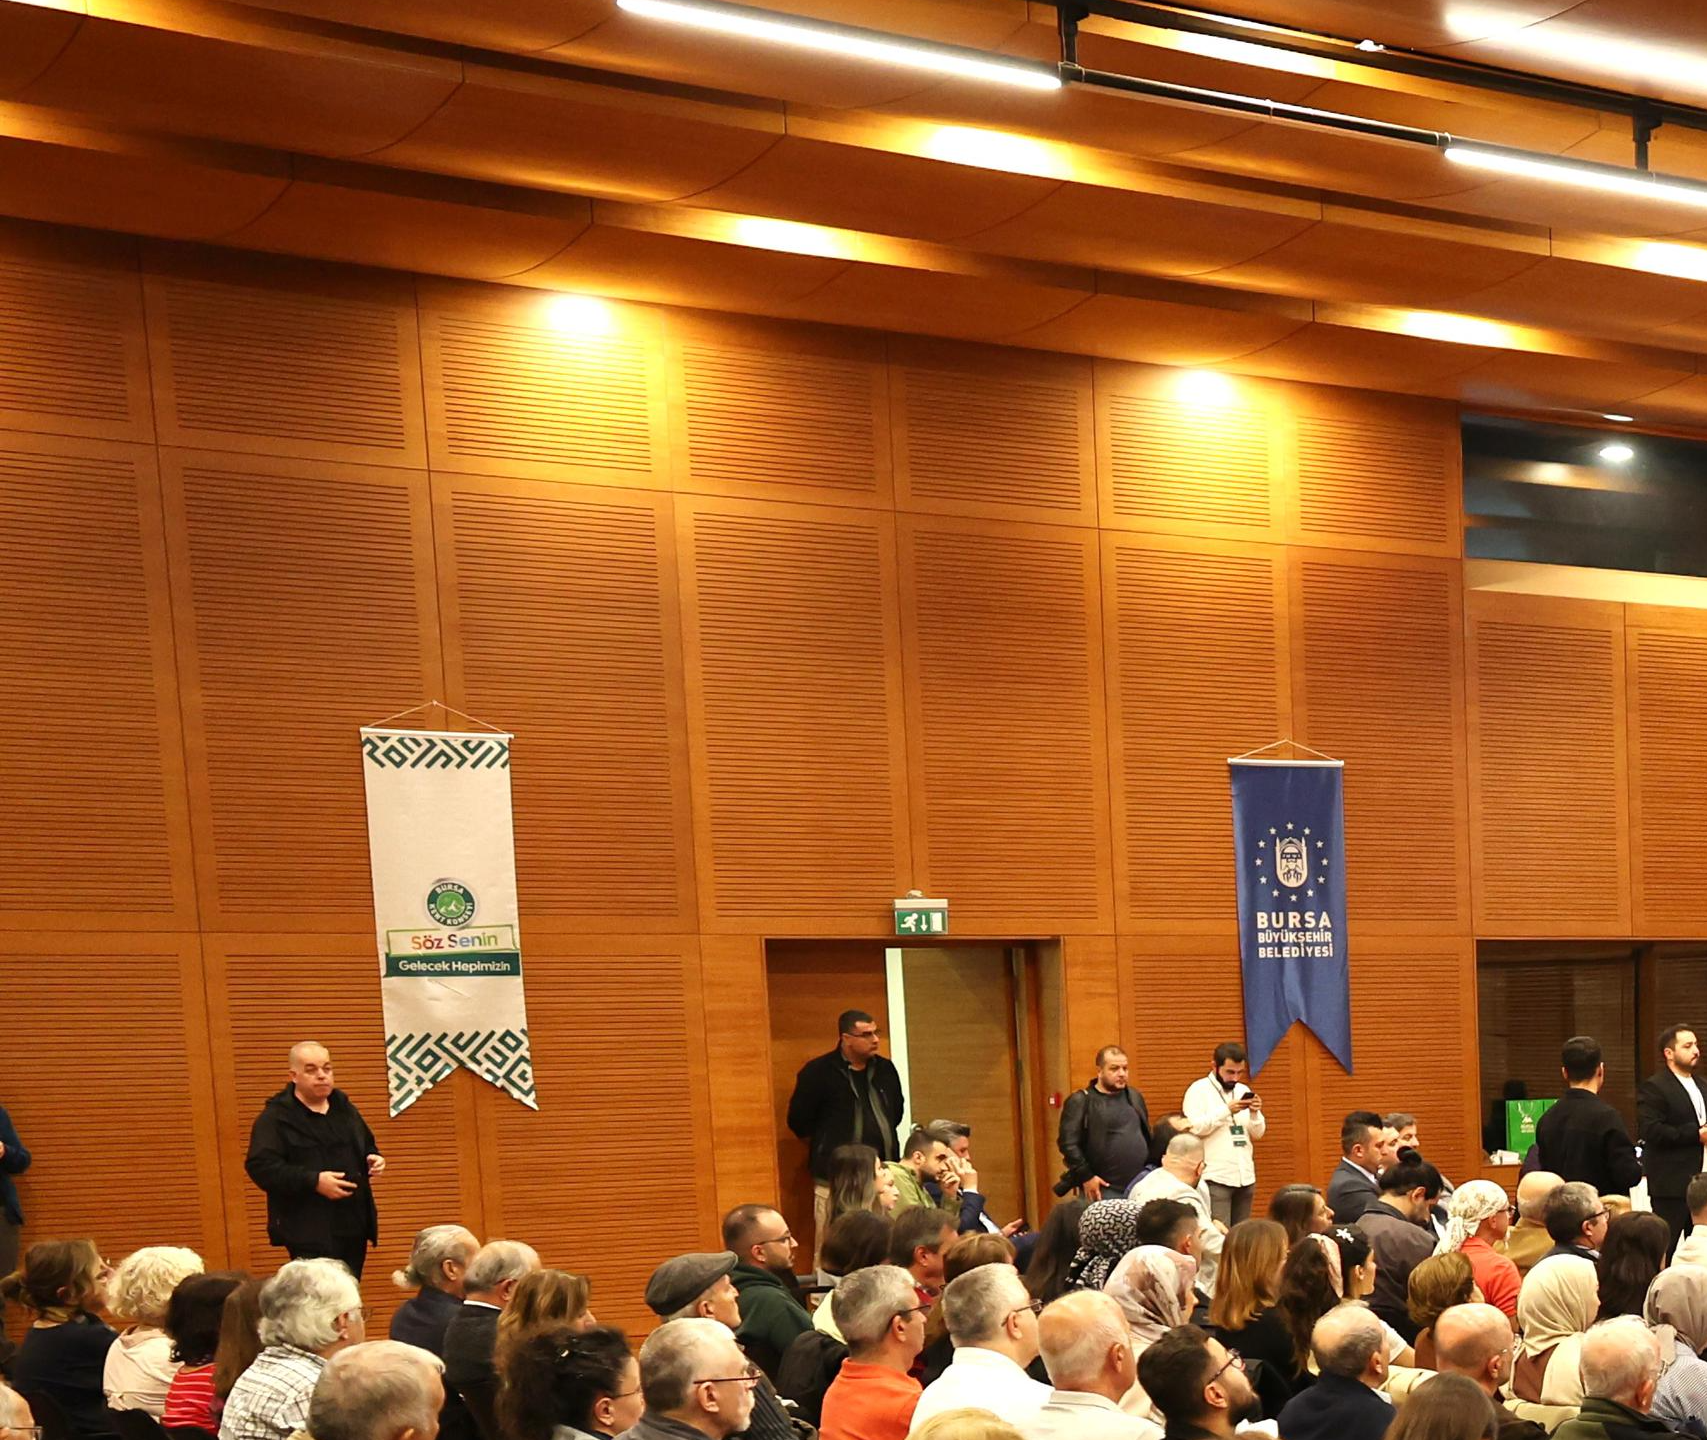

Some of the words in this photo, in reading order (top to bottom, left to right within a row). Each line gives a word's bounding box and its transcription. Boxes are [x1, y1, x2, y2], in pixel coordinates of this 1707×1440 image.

[1256, 911, 1332, 929] BURSA
[411, 934, 444, 950] Söz
[448, 931, 498, 948] Senin
[1257, 929, 1333, 943] BÜYÜKŞEHİR
[1258, 943, 1334, 958] BELEDİYESİ
[399, 960, 450, 971] Gelecek
[452, 960, 511, 973] Hepimizin
